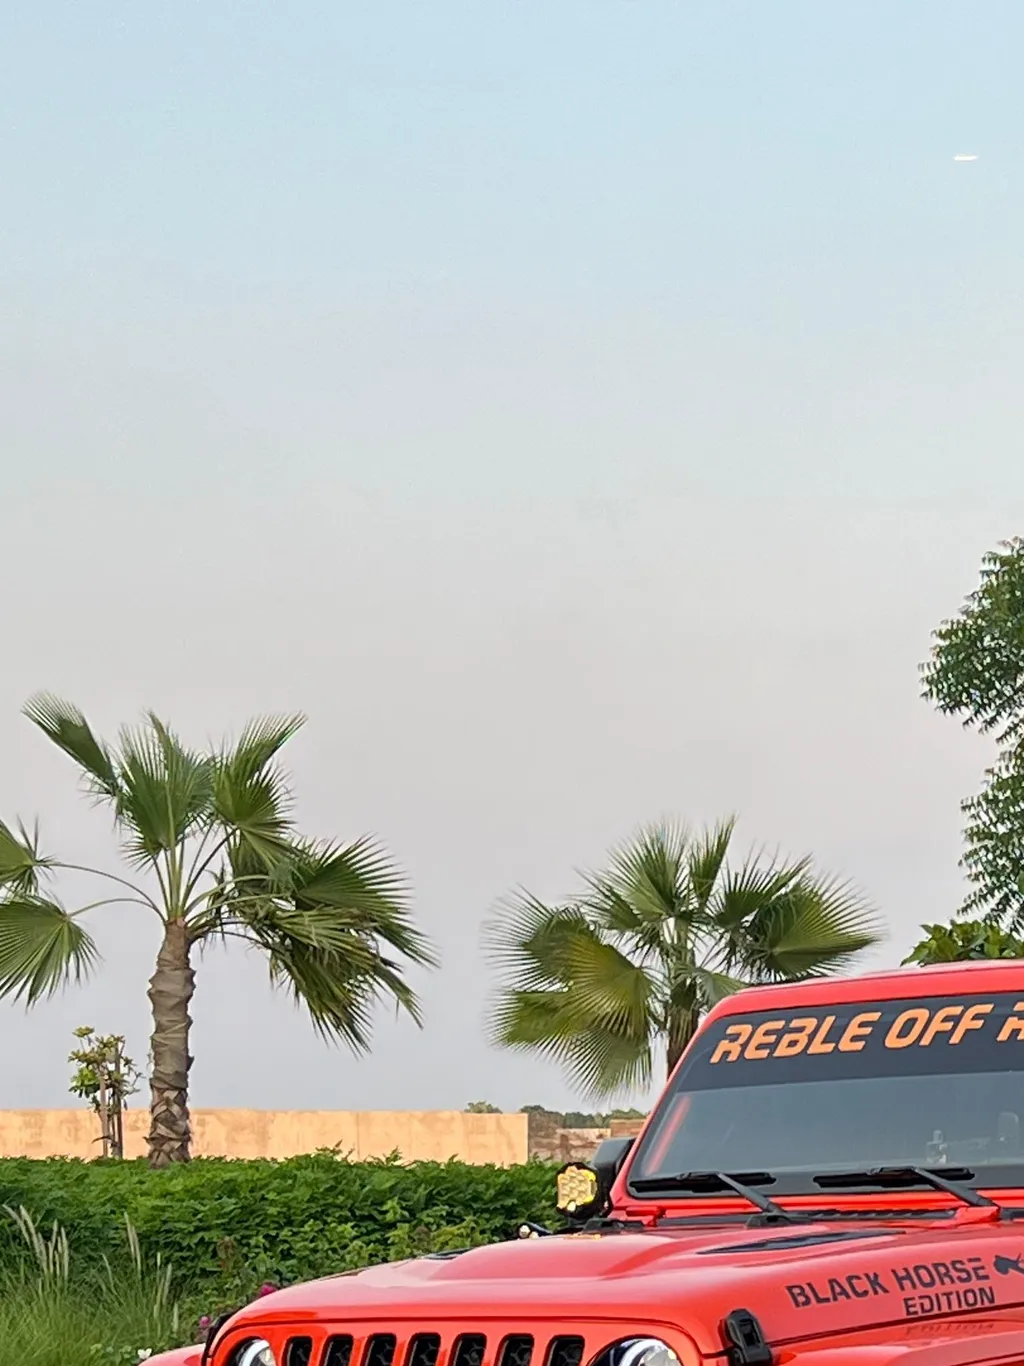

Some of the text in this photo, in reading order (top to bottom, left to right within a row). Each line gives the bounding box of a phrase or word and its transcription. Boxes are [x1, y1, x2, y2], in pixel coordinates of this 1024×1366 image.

[710, 1011, 881, 1064] REBLE
[884, 1003, 995, 1048] OFF
[785, 1256, 991, 1309] BLACK HORSE
[902, 1285, 996, 1317] EDITION
